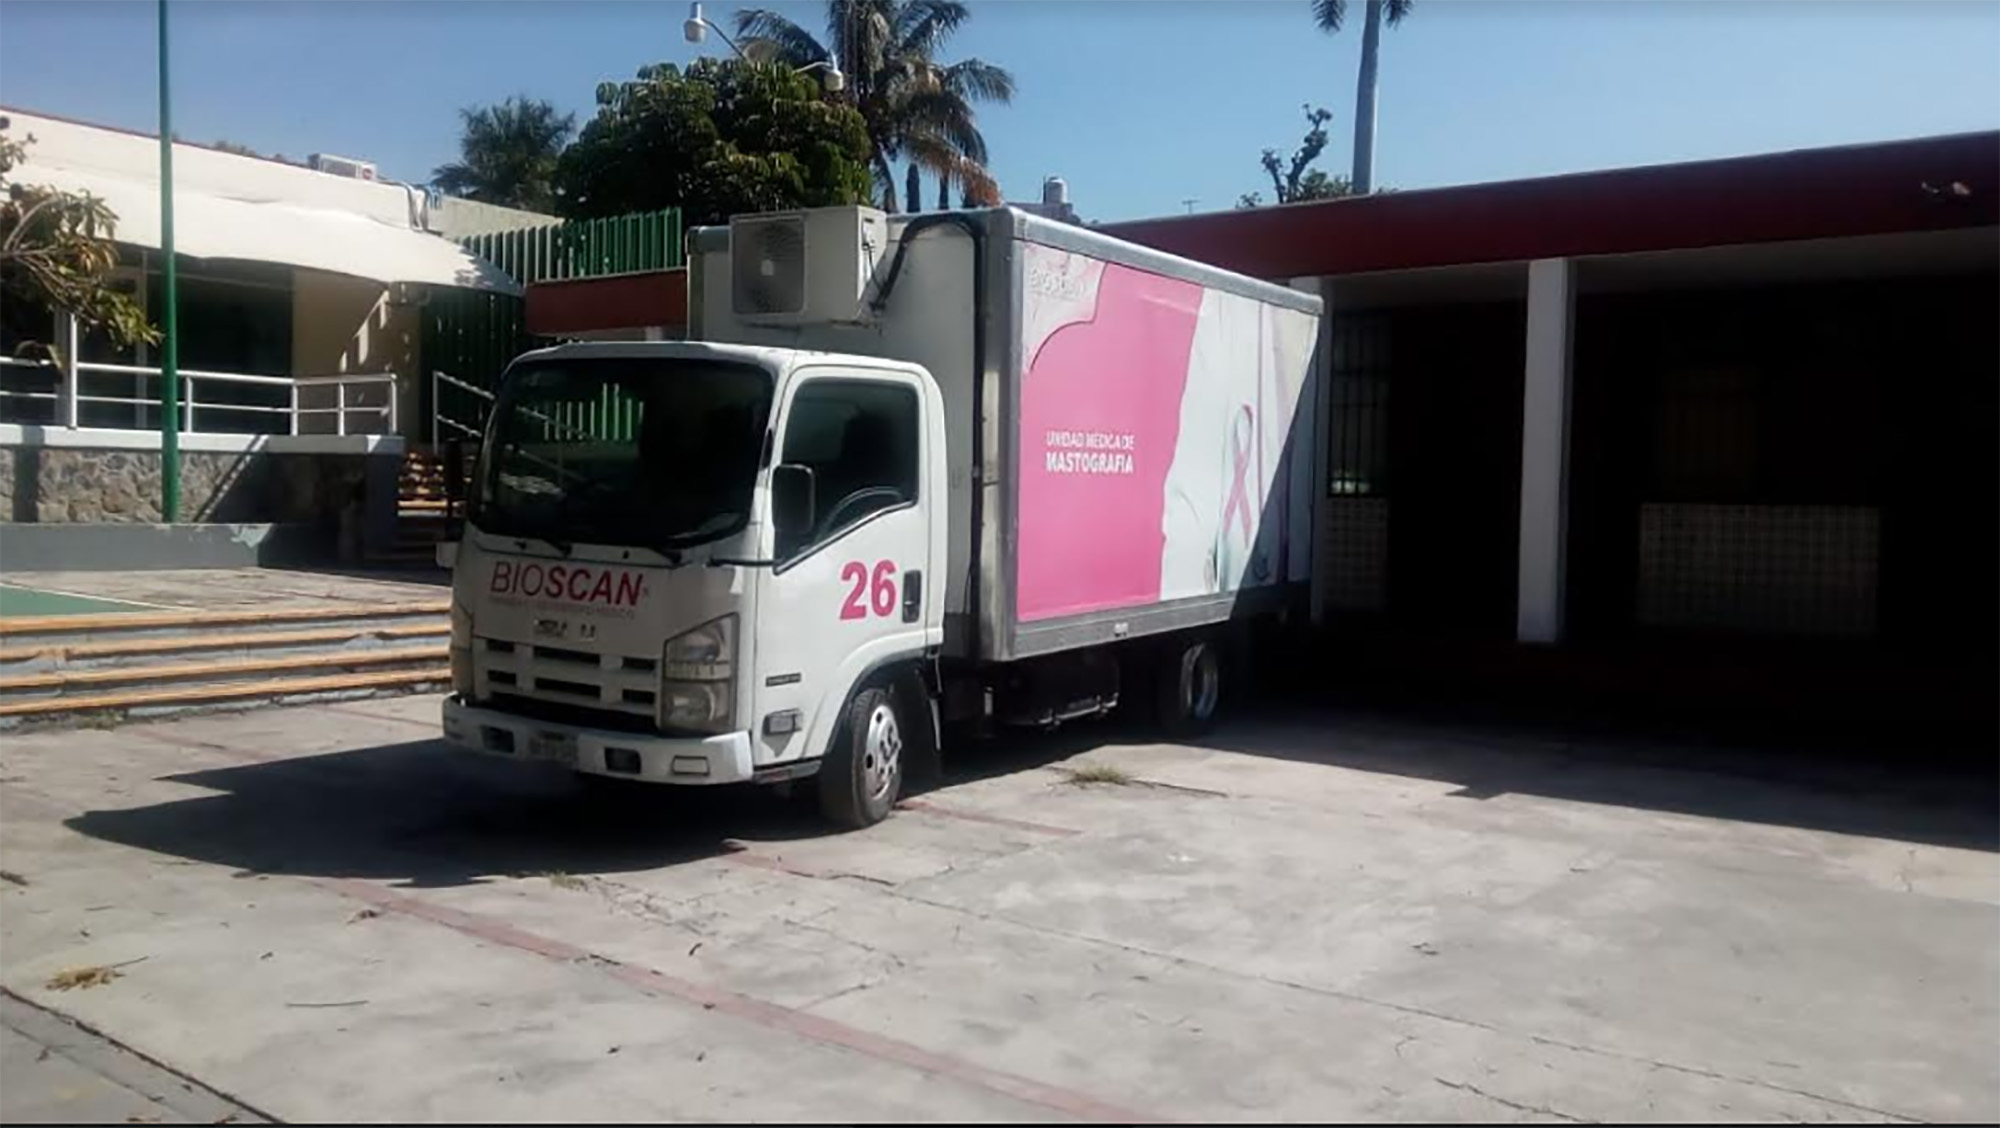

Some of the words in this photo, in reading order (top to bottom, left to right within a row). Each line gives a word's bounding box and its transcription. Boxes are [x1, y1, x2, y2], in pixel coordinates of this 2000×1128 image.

[1046, 431, 1084, 447] UNIDAD
[1121, 434, 1135, 450] DE
[490, 561, 643, 606] BIOSCAN
[840, 560, 896, 620] 26
